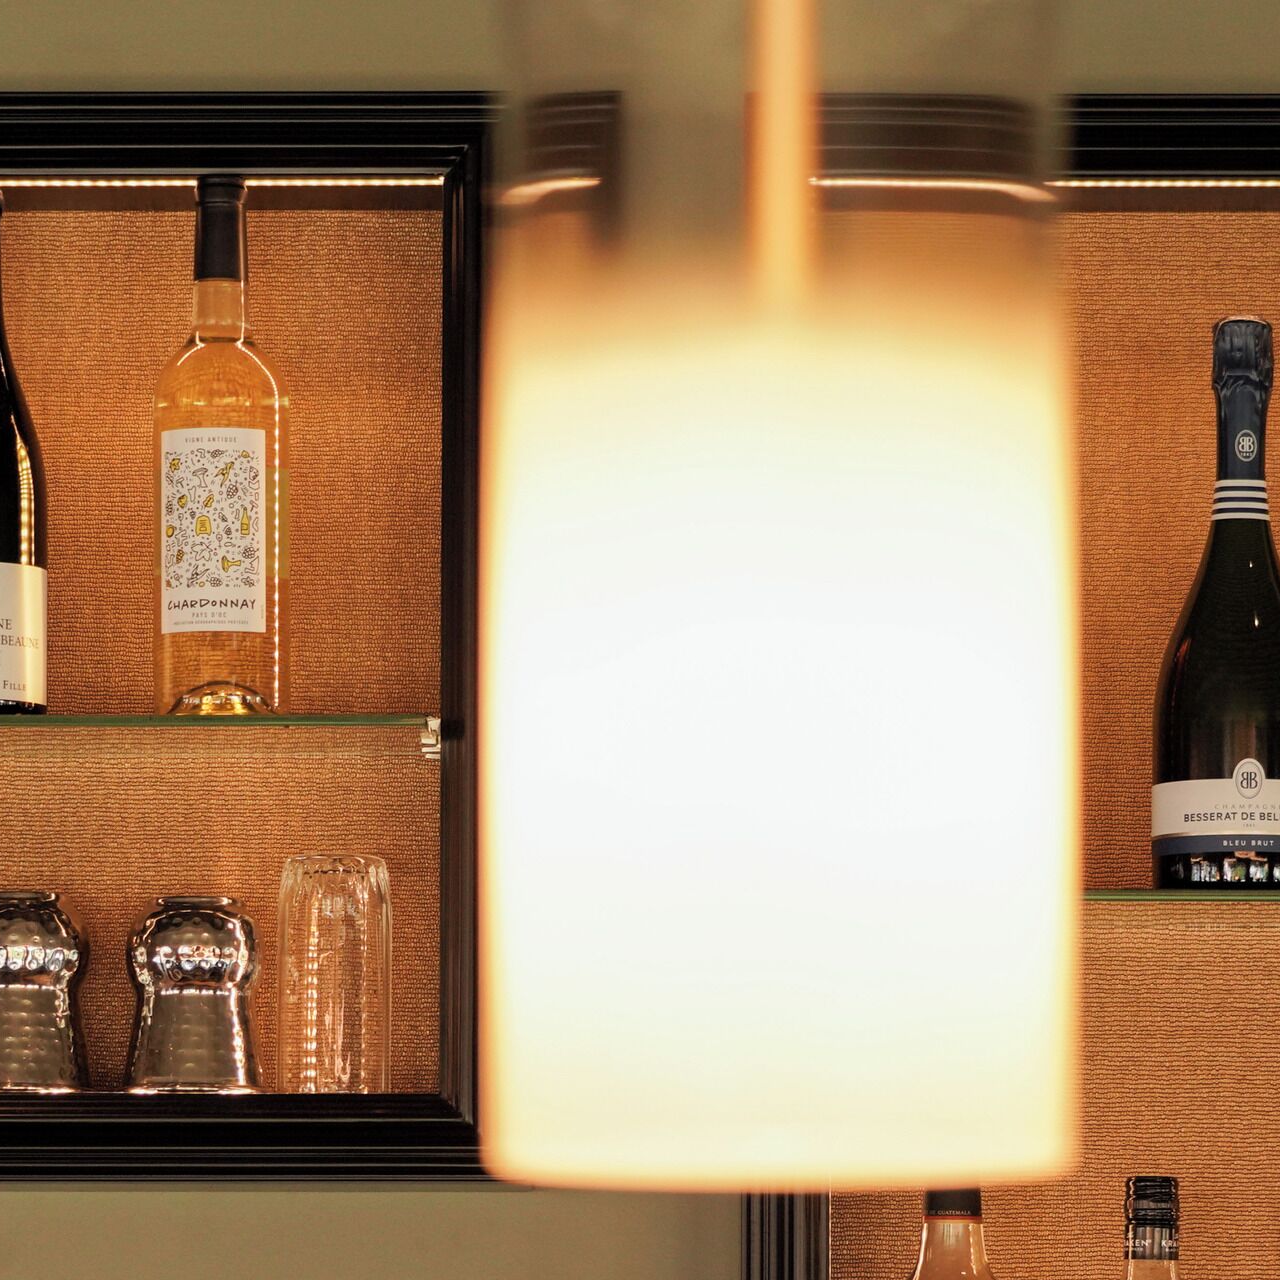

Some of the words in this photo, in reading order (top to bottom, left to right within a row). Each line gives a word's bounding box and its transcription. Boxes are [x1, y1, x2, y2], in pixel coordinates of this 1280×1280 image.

[185, 436, 205, 444] VIGNE
[208, 436, 238, 444] ANTIQUE
[167, 598, 257, 611] CHARDONNAY
[1, 634, 40, 650] BEAUNE
[1183, 812, 1238, 823] BESSERAT
[1241, 812, 1255, 821] DE
